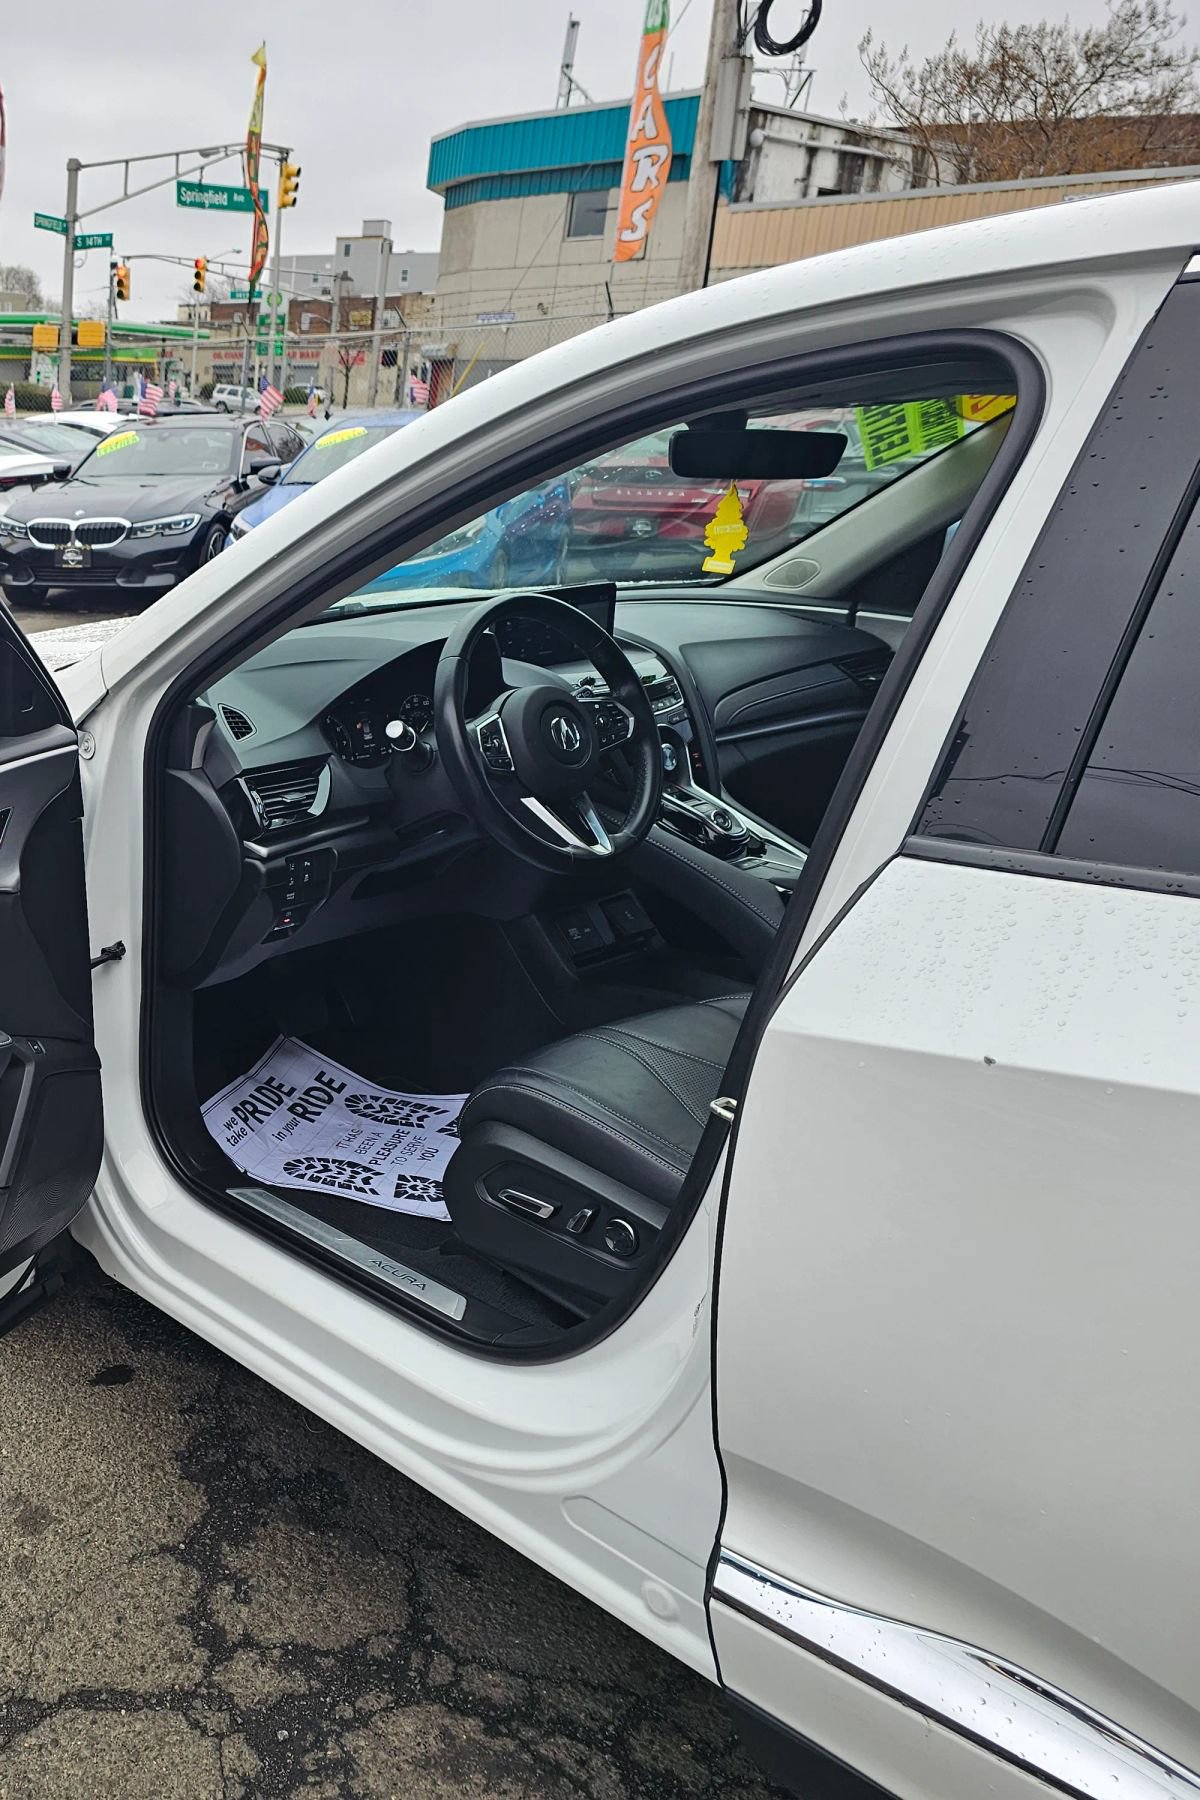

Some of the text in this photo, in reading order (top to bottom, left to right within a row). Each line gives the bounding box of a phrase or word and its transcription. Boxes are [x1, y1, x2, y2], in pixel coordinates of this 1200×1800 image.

[180, 186, 228, 208] Springfield
[76, 237, 82, 247] S
[86, 236, 103, 247] 14TH
[226, 1076, 297, 1147] take PRIDE
[272, 1070, 348, 1142] in your RIDE
[223, 1116, 238, 1131] we
[354, 1136, 378, 1155] BEEN
[368, 1128, 411, 1166] PLEASURE
[390, 1135, 428, 1166] TO SERVE
[417, 1147, 439, 1161] YOU
[368, 1260, 426, 1290] ACURA
